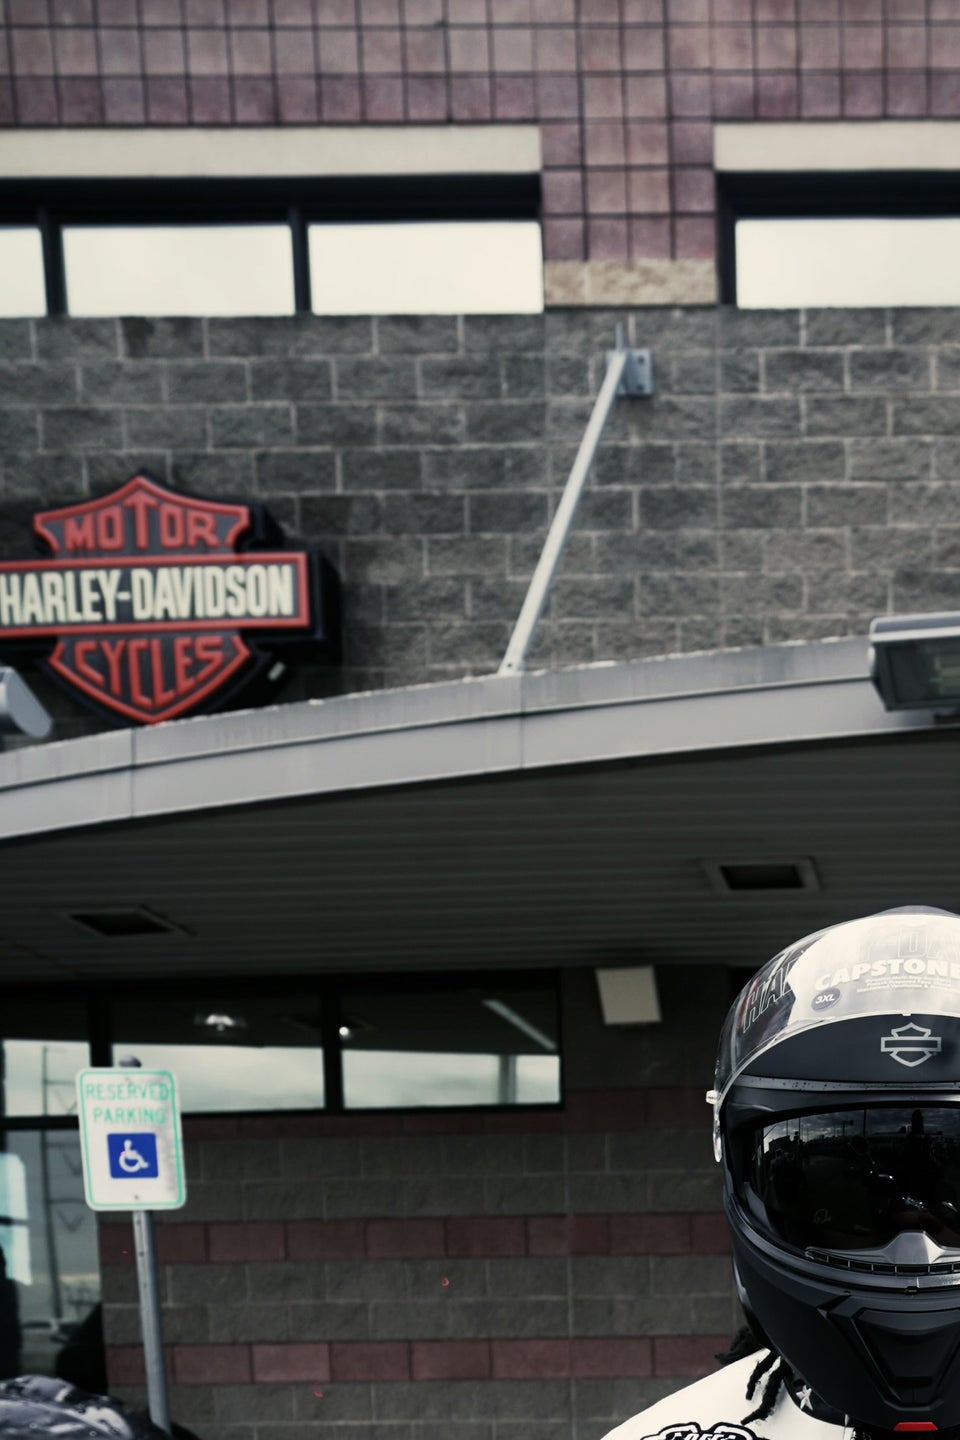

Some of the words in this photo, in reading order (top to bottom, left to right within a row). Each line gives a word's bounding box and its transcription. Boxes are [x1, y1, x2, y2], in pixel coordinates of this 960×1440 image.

[63, 491, 220, 551] MOTOR
[0, 563, 293, 626] HARLEY-DAVIDSON
[73, 635, 225, 708] CYCLES
[815, 993, 836, 1005] 3XL
[85, 1082, 170, 1100] RESERVED
[93, 1106, 168, 1124] PARKING
